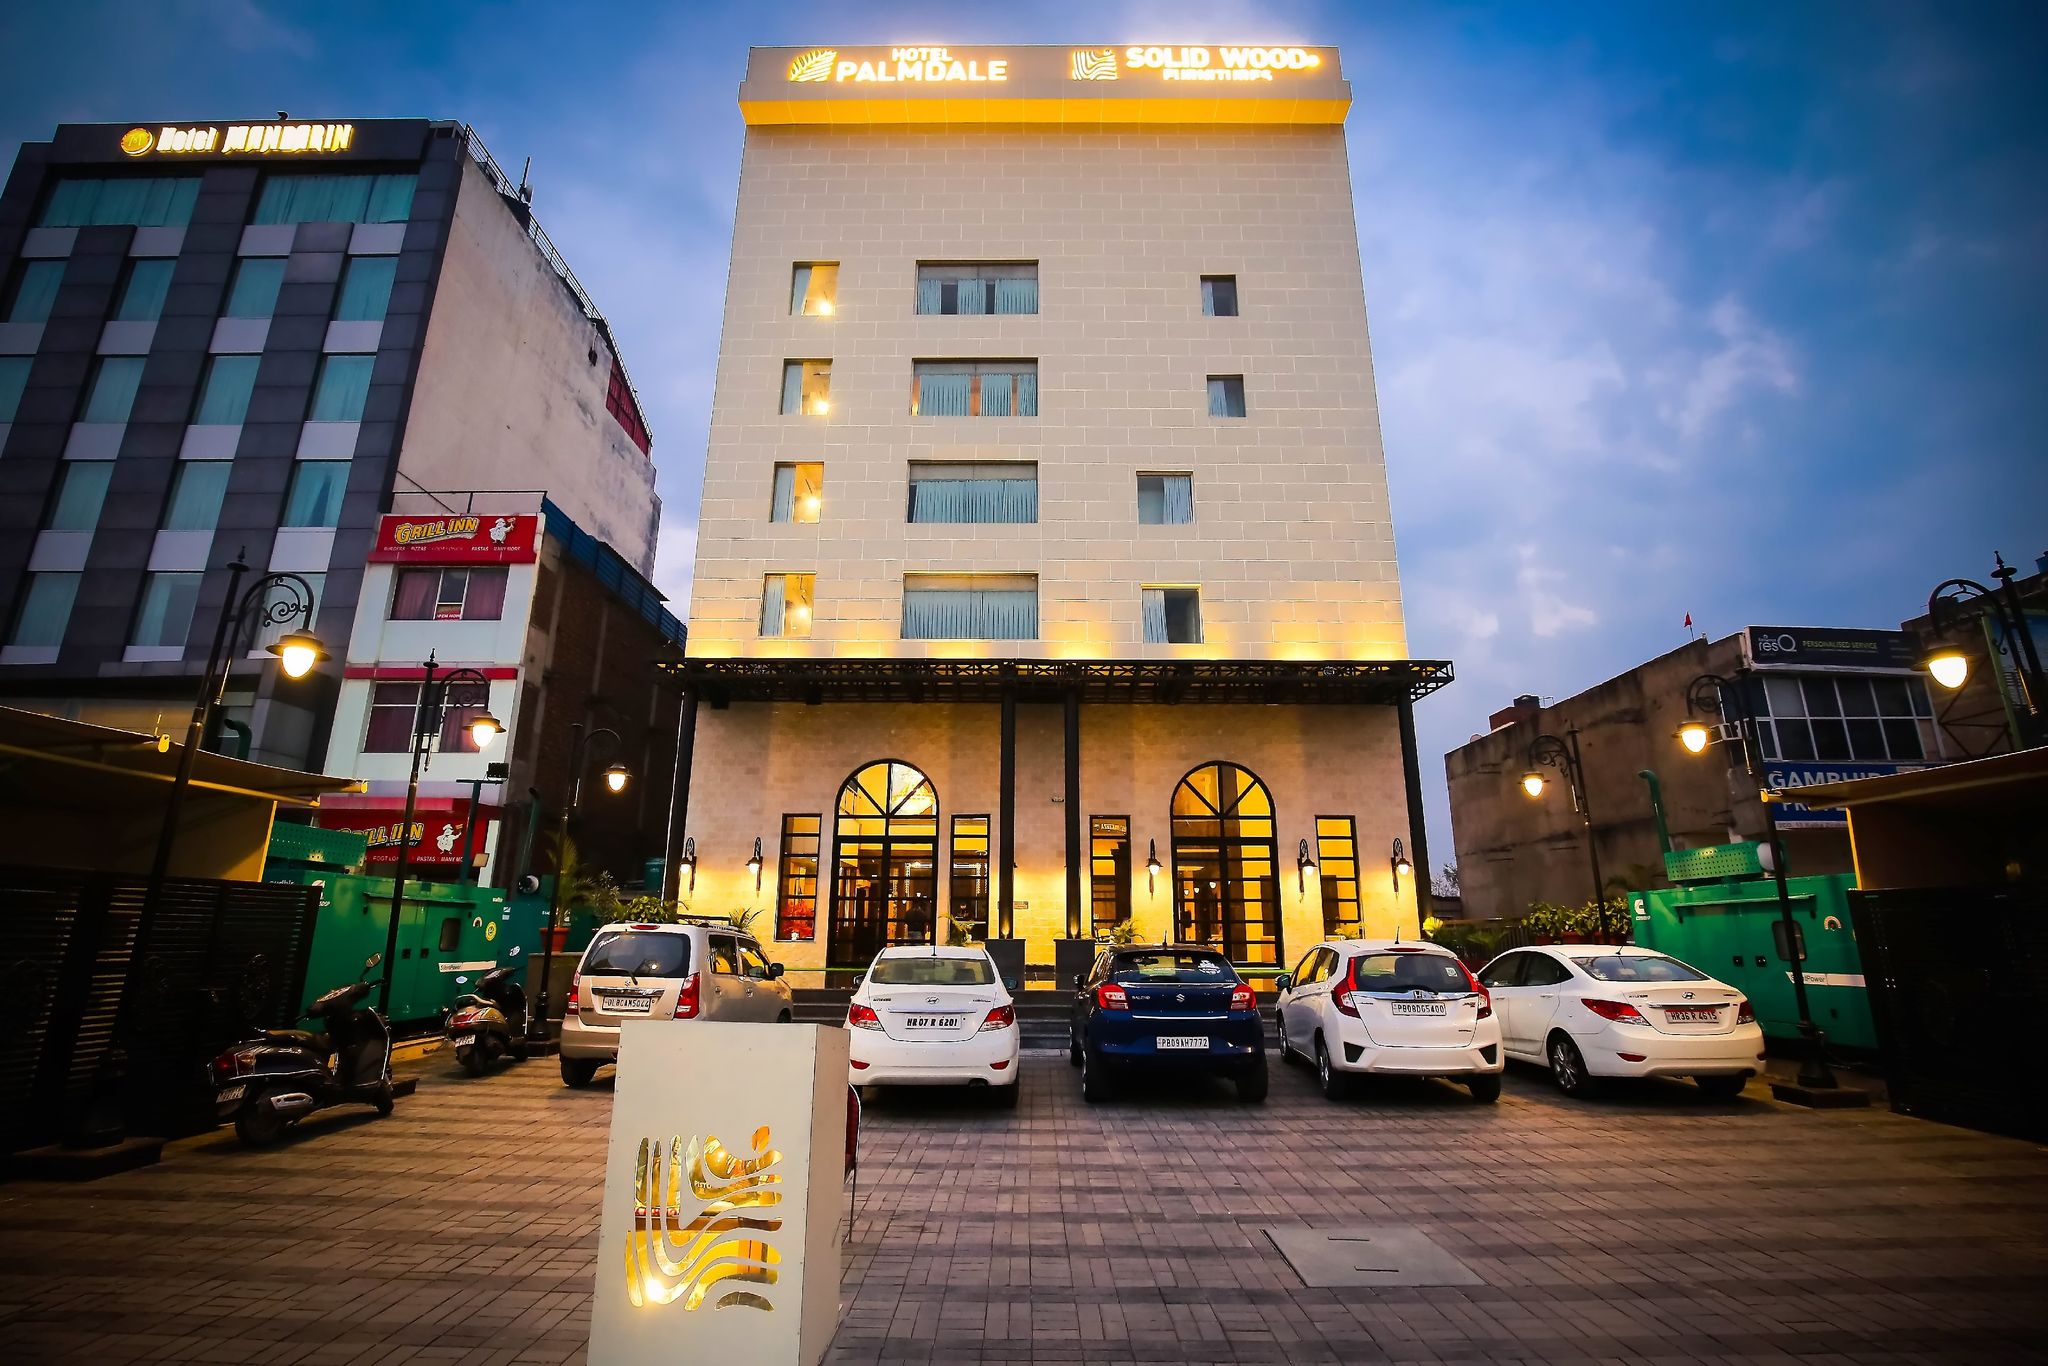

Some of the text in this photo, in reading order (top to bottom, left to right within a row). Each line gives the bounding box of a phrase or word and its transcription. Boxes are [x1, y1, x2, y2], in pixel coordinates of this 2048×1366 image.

[892, 48, 953, 62] HOTEL
[1126, 48, 1308, 69] SOLID WOOD
[836, 61, 1008, 82] PALMDALE
[156, 125, 352, 153] Hotel MANDARIN
[395, 517, 480, 544] GRILL INN
[938, 1018, 958, 1027] 6201
[1161, 1037, 1208, 1048] PB09AH7772
